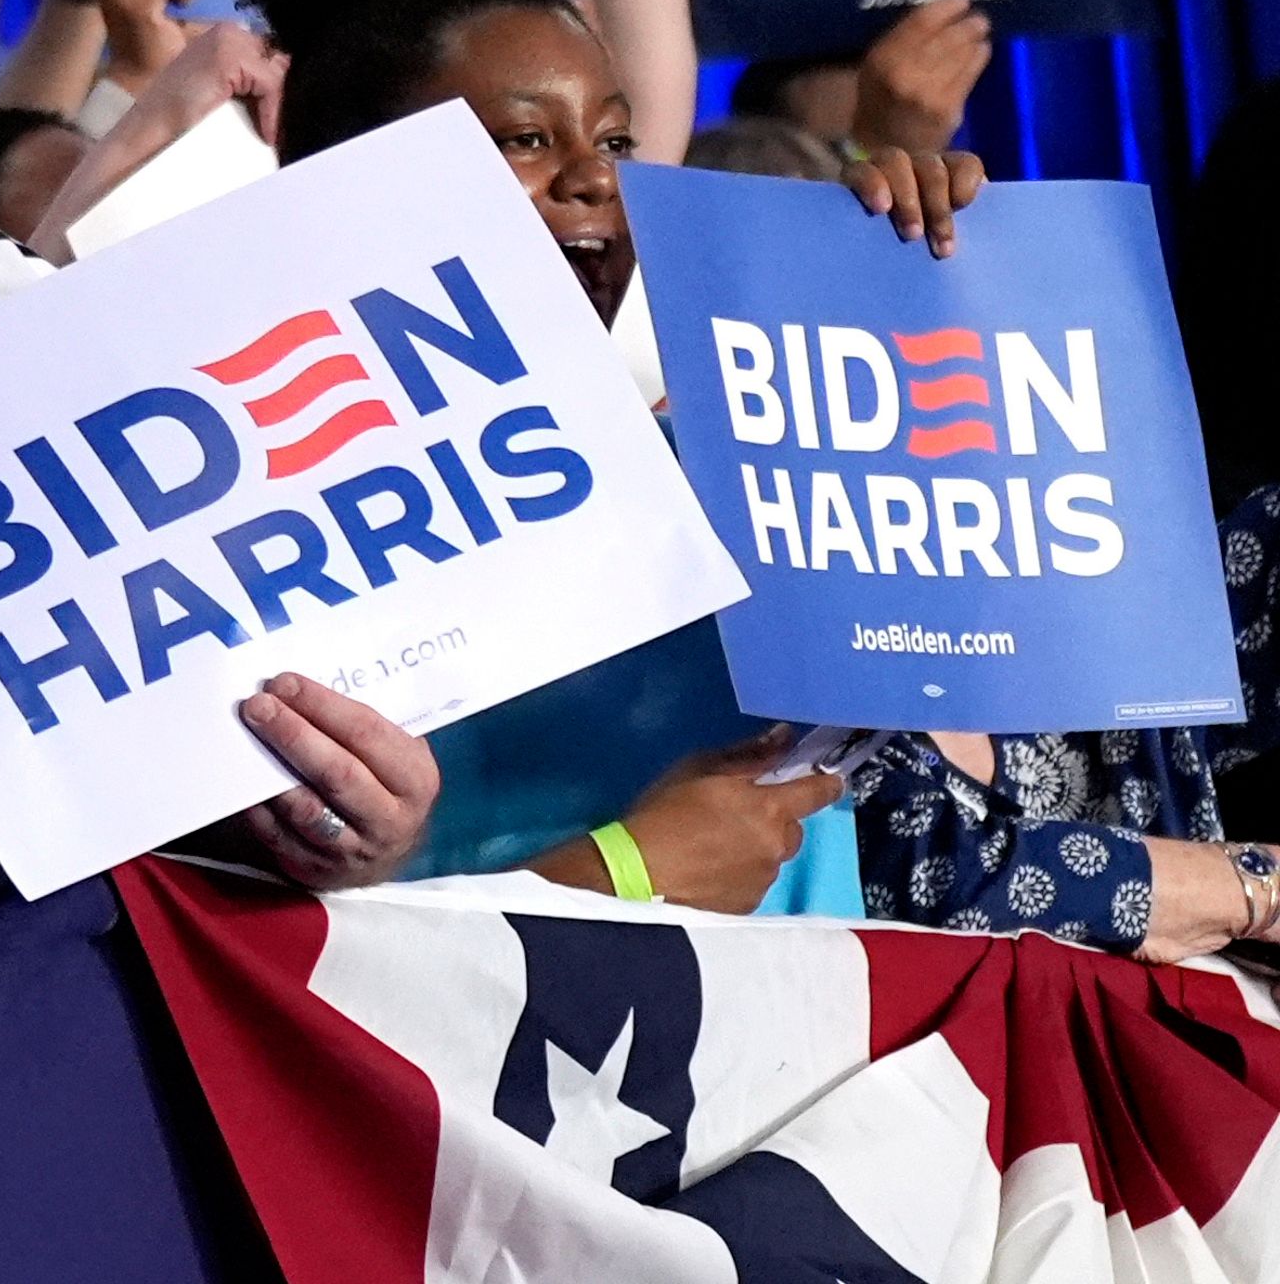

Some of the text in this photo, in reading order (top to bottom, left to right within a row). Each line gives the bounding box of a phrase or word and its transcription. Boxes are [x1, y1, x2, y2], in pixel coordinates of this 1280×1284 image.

[711, 317, 1107, 459] BIDEN
[741, 463, 1125, 578] HARRIS
[851, 622, 1015, 656] JoeBiden.com
